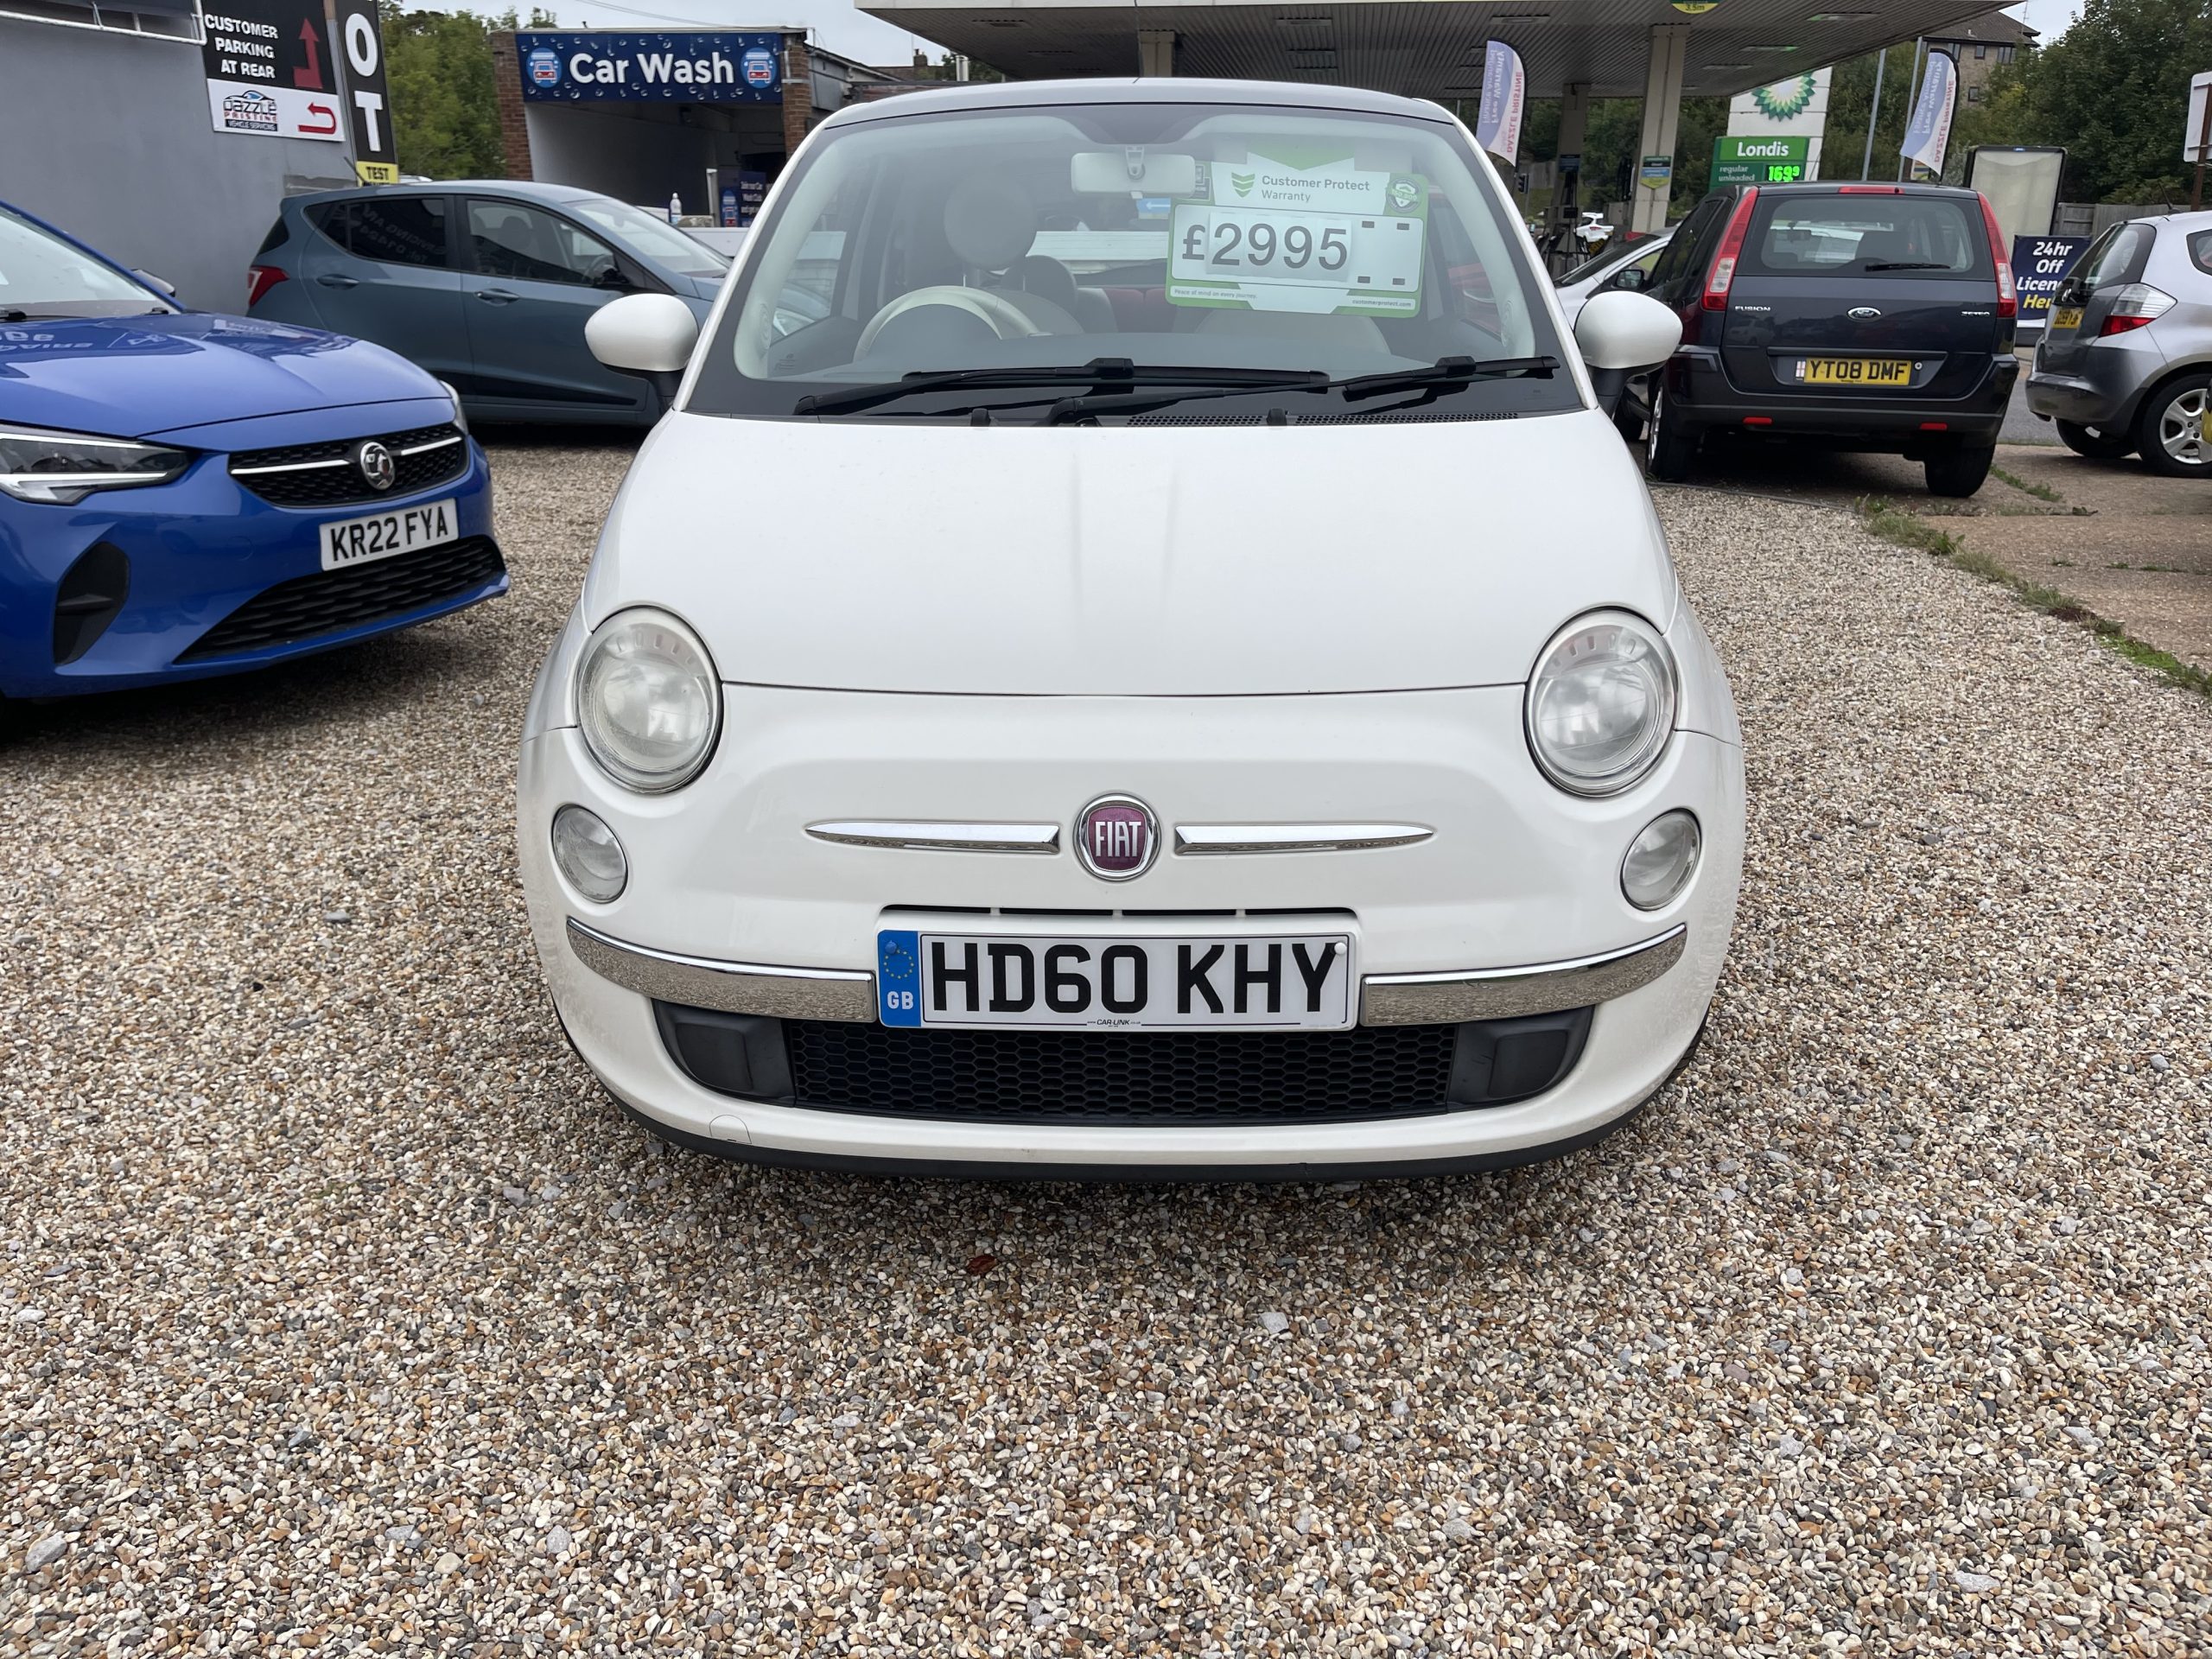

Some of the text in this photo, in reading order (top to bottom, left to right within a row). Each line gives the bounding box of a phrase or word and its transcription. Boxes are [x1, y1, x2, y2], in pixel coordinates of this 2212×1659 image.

[205, 14, 278, 39] CUSTOMER
[214, 37, 275, 59] PARKING
[220, 59, 276, 79] AT REAR
[569, 52, 734, 84] Car Wash
[1737, 141, 1789, 157] Londis
[365, 166, 389, 181] TEST
[1718, 174, 1755, 182] unleaded
[1719, 165, 1749, 175] regular
[1262, 175, 1370, 193] Customer Protect
[1262, 189, 1312, 204] Warranty
[1182, 222, 1348, 270] £2995
[2032, 242, 2073, 257] 24hr
[2036, 258, 2065, 274] Off
[1351, 299, 1412, 308] customerprotect.com
[1809, 359, 1909, 381] YT08 DMF
[330, 505, 448, 562] KR22 FYA
[1095, 821, 1142, 858] FIAT
[931, 942, 1337, 1014] HD60 KHY
[887, 991, 914, 1010] GB
